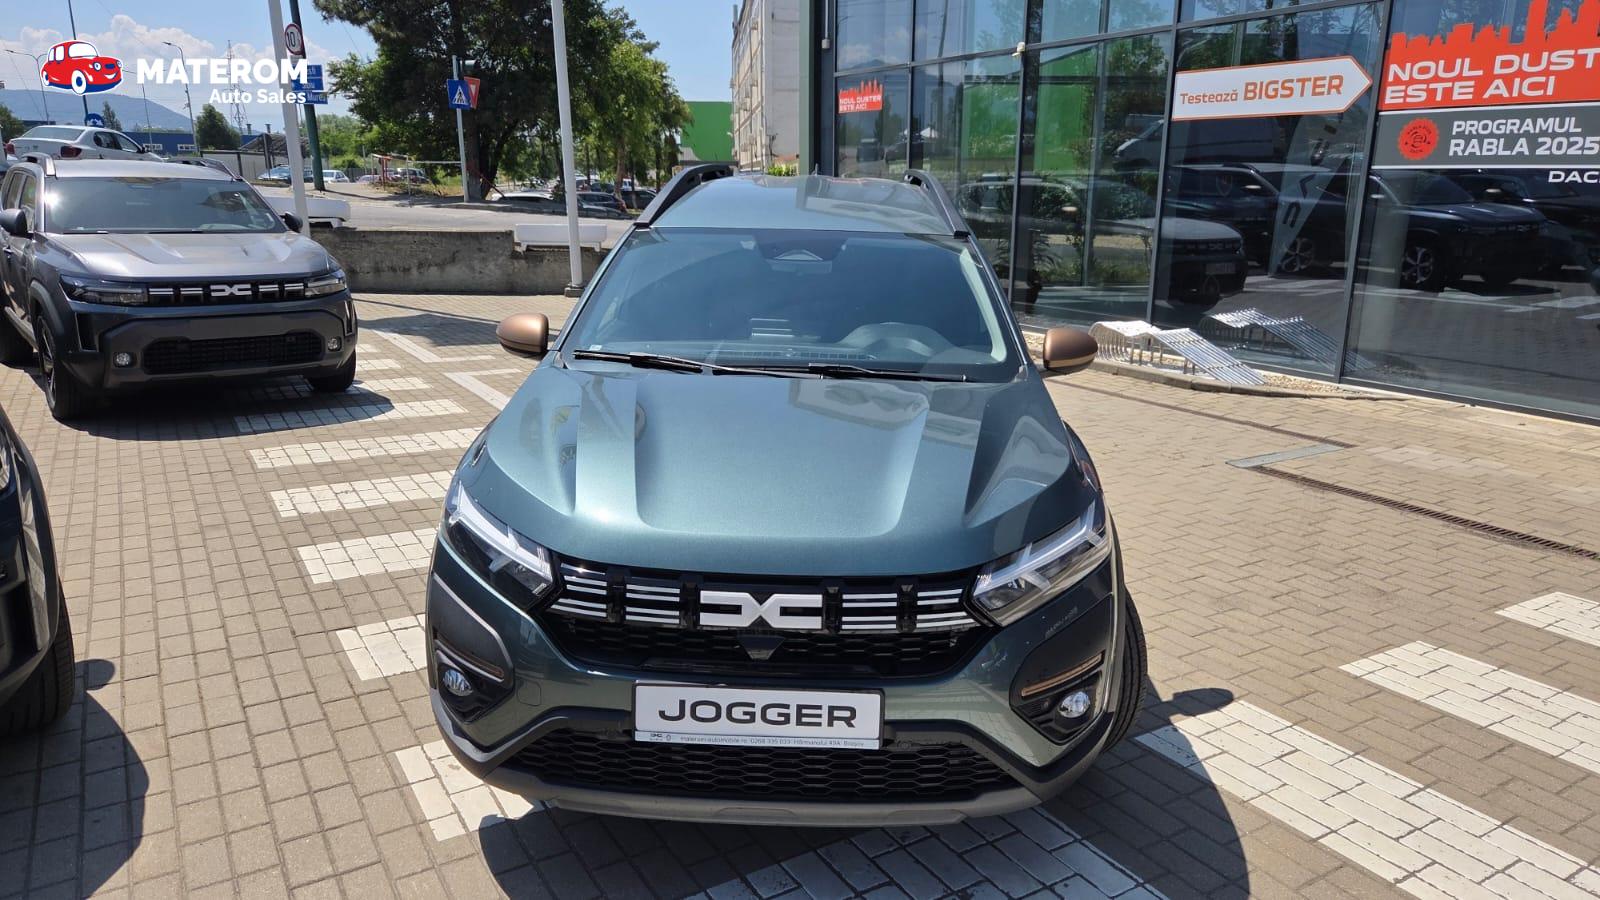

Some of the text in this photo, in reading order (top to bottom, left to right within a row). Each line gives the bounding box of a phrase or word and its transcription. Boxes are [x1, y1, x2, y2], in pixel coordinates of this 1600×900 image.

[286, 31, 296, 48] 10
[1387, 57, 1483, 82] NOUL
[1180, 75, 1344, 104] Testează BIGSTER
[1384, 76, 1556, 104] ESTE AICI
[1452, 117, 1582, 135] PROGRAMUL
[1449, 136, 1600, 156] RABLA 2025
[1548, 170, 1600, 184] DAC
[658, 699, 857, 728] JOGGER
